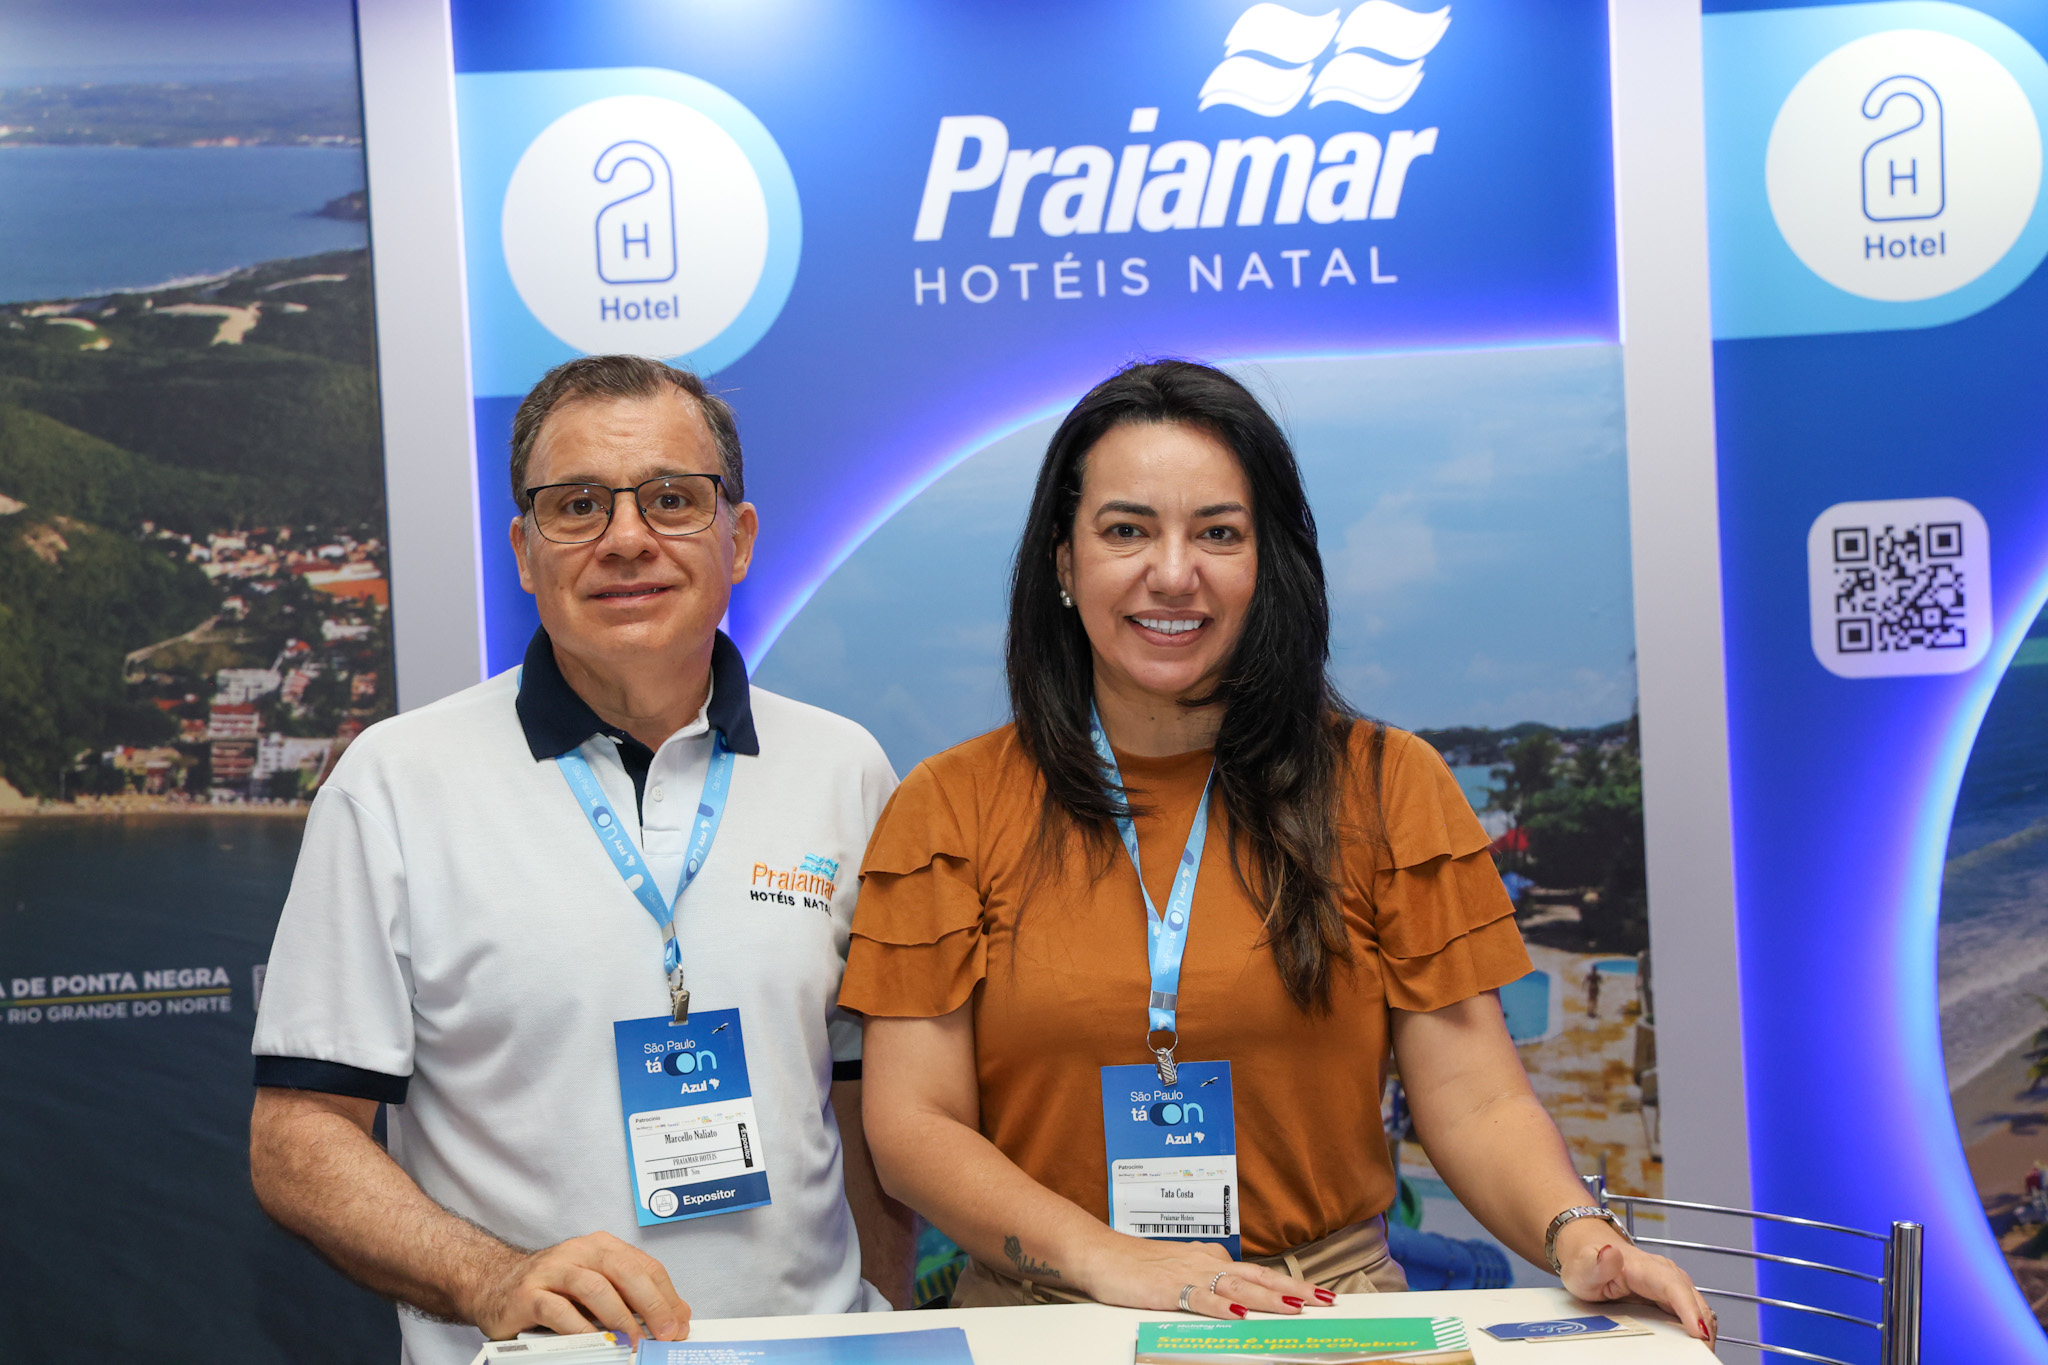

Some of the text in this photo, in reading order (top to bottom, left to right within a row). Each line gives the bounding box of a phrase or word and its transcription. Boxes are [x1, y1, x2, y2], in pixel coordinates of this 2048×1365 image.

[913, 107, 1439, 242] Praiamar
[1890, 158, 1917, 196] H
[622, 223, 650, 259] H
[1865, 230, 1945, 259] Hotel
[915, 246, 1398, 306] HOTÉIS NATAL
[600, 295, 678, 321] Hotel
[752, 862, 837, 901] Praiamar
[750, 890, 795, 906] HOTÉIS
[12, 977, 47, 998] DE
[52, 971, 137, 995] PONTA
[143, 966, 230, 990] NEGRA
[8, 996, 232, 1024] RIO GRANDE DO NORTE
[644, 1038, 696, 1054] São Paulo
[645, 1056, 662, 1073] tá
[680, 1080, 708, 1095] Azul
[1130, 1089, 1183, 1102] São Paulo
[1131, 1105, 1148, 1121] tá
[664, 1129, 718, 1144] Marcello Naliato
[1165, 1132, 1192, 1145] Azul
[672, 1156, 700, 1166] PRAIAMAR
[682, 1187, 737, 1207] Expositor
[1160, 1188, 1194, 1198] Tata Costa
[1160, 1213, 1180, 1221] Praiamar
[1157, 1336, 1241, 1345] Sempre
[1269, 1343, 1320, 1351] para
[1326, 1341, 1419, 1349] celebrar
